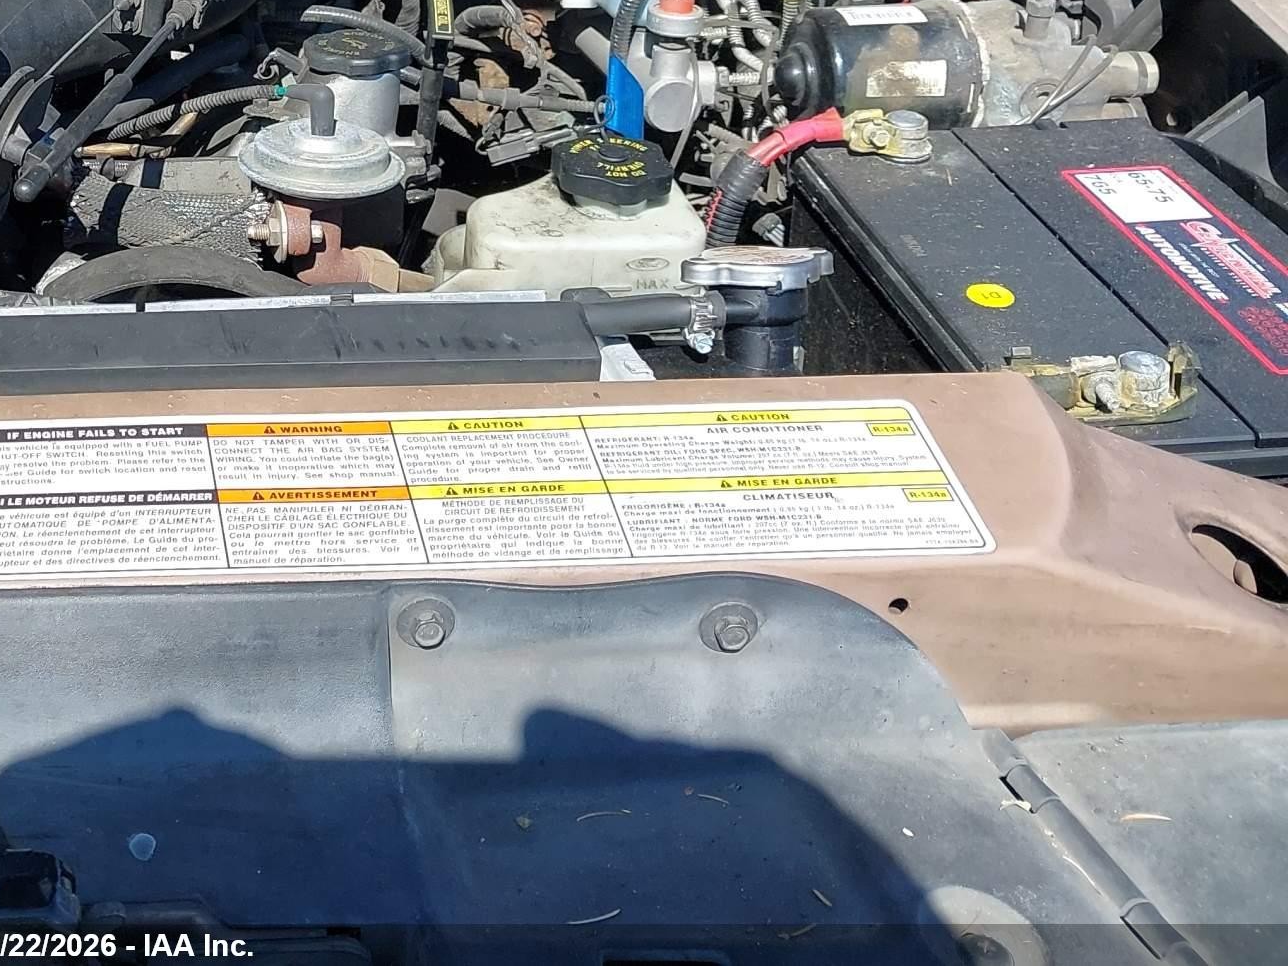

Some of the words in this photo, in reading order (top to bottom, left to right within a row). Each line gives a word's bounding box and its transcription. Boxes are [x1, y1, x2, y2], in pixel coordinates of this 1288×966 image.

[438, 15, 449, 26] OIL
[596, 137, 649, 152] SEERING
[596, 161, 645, 172] OVERFILL
[1135, 225, 1229, 301] AUTOMOTIVE
[636, 278, 669, 291] MAX
[24, 430, 74, 439] ENGINE
[78, 429, 116, 437] FAILS
[119, 428, 137, 436] TO
[141, 427, 183, 435] START
[732, 424, 823, 432] CONDITIONER
[64, 442, 109, 450] equipped
[7, 497, 23, 505] LE
[25, 496, 76, 504] MOTEUR
[78, 494, 126, 503] REFUSE
[128, 494, 144, 502] DE
[147, 491, 213, 501] DÉMARRER
[269, 490, 378, 498] AVERTISSEMENT
[743, 492, 835, 500] CLIMATISEUR
